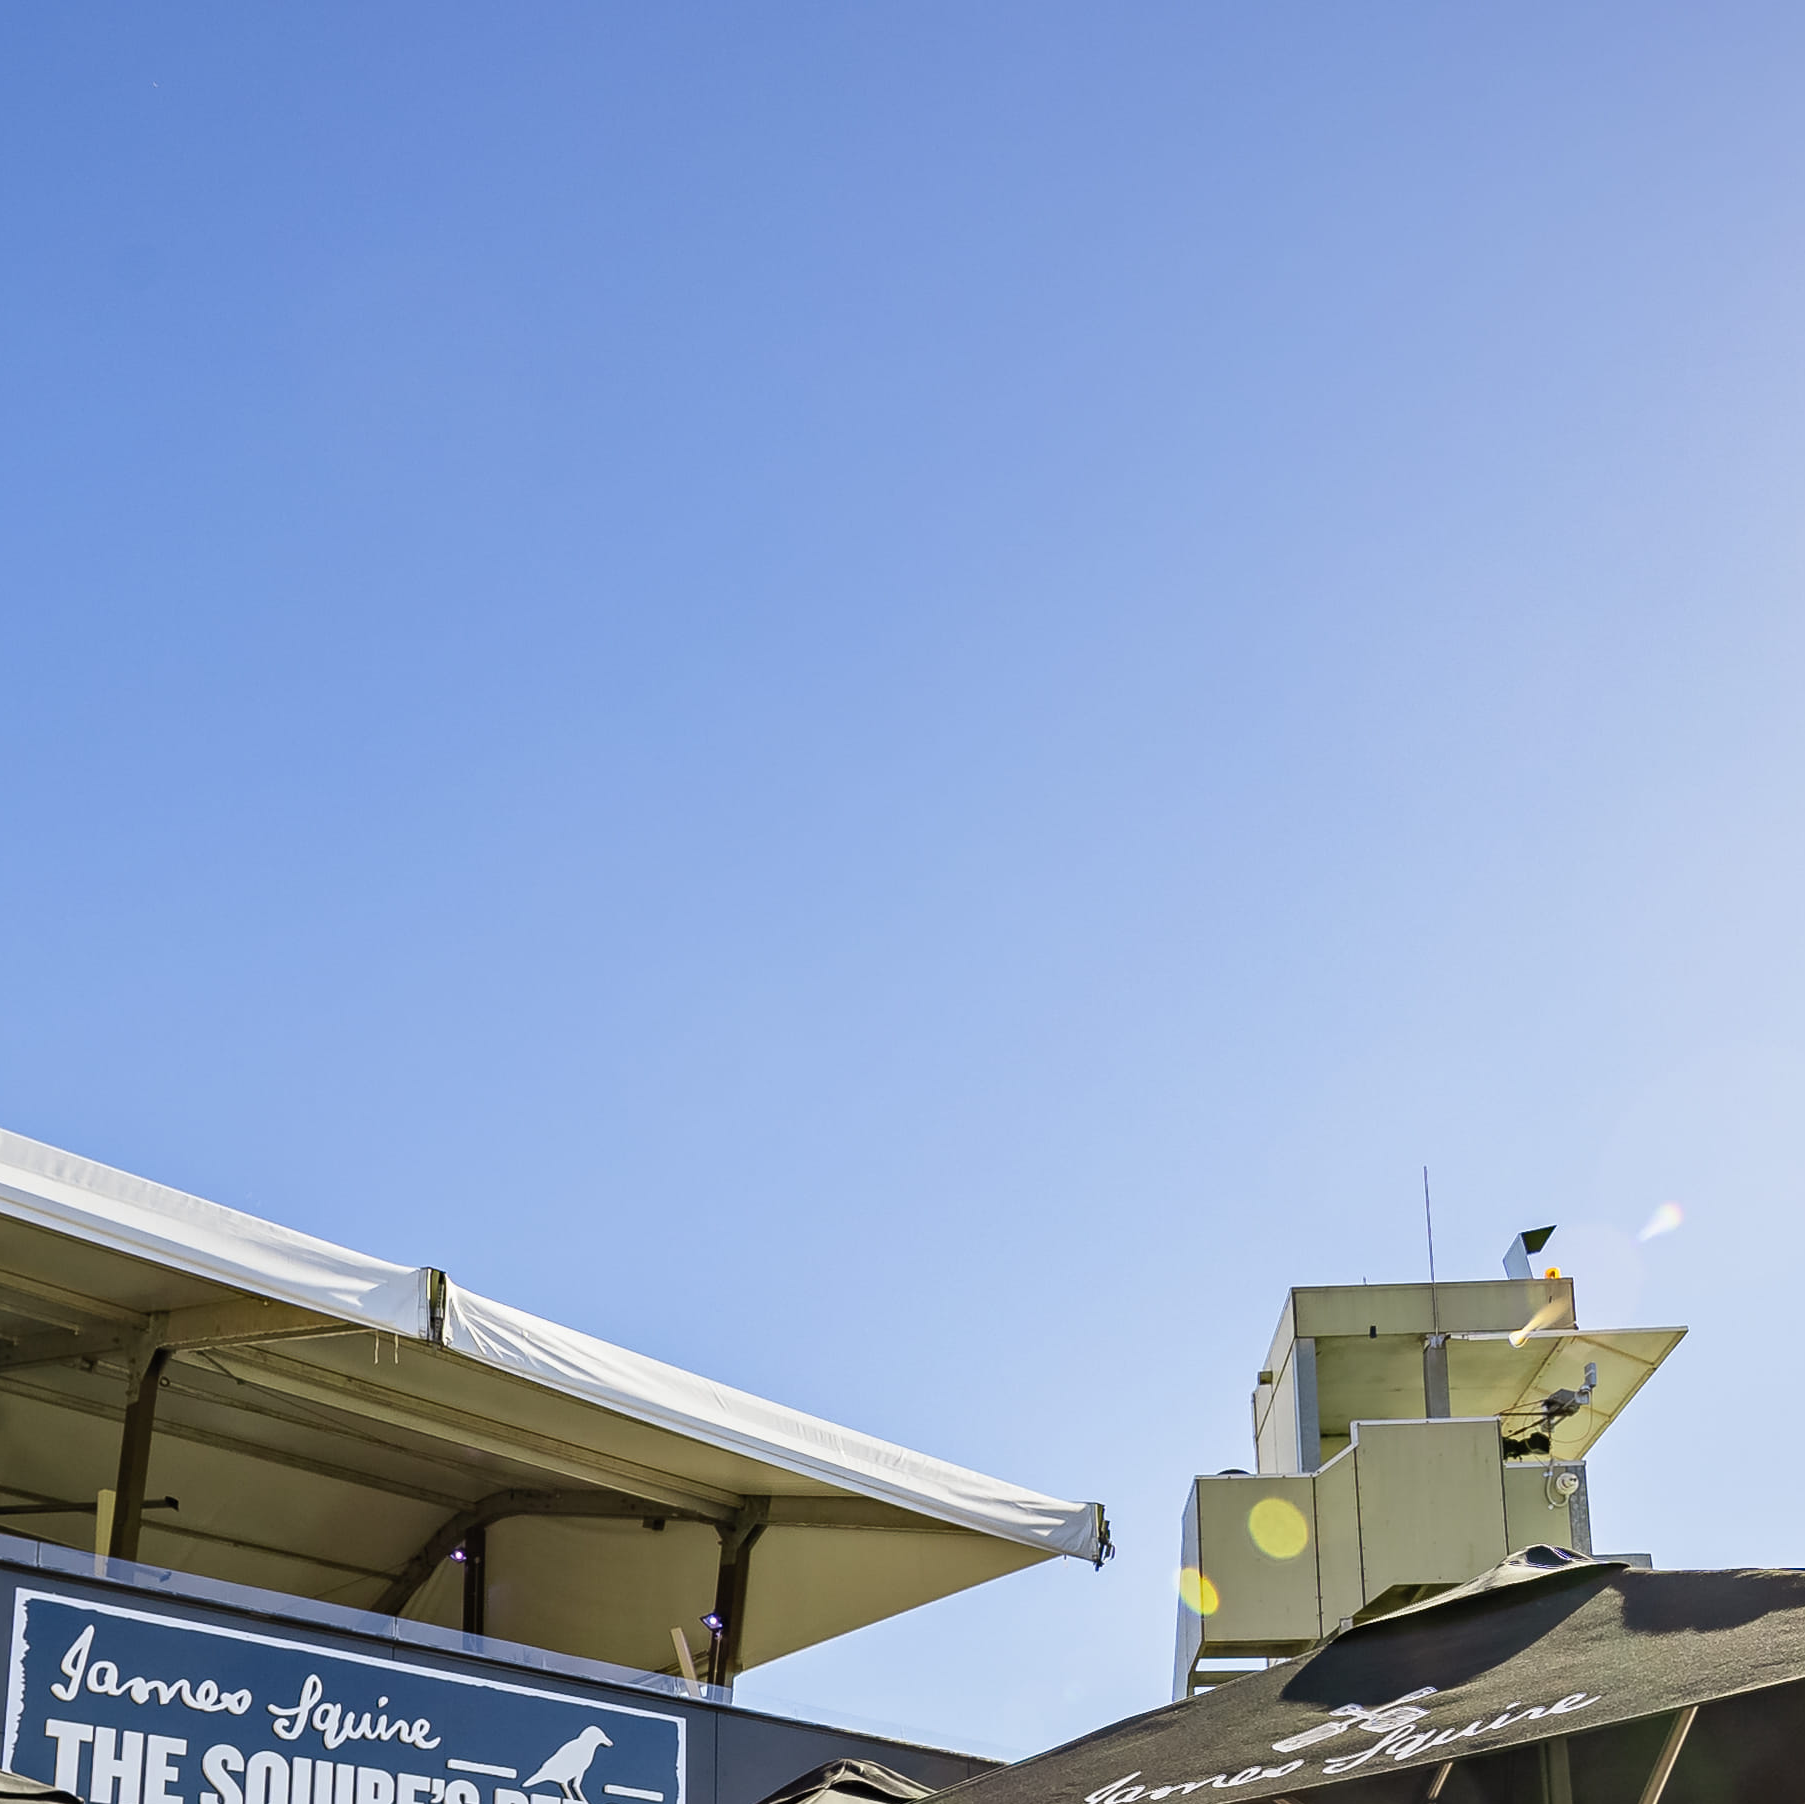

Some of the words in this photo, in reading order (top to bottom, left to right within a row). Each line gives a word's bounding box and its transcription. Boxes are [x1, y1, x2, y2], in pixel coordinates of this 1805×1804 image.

[51, 1625, 253, 1713] James
[267, 1673, 442, 1750] Squire
[1323, 1691, 1601, 1776] Squire
